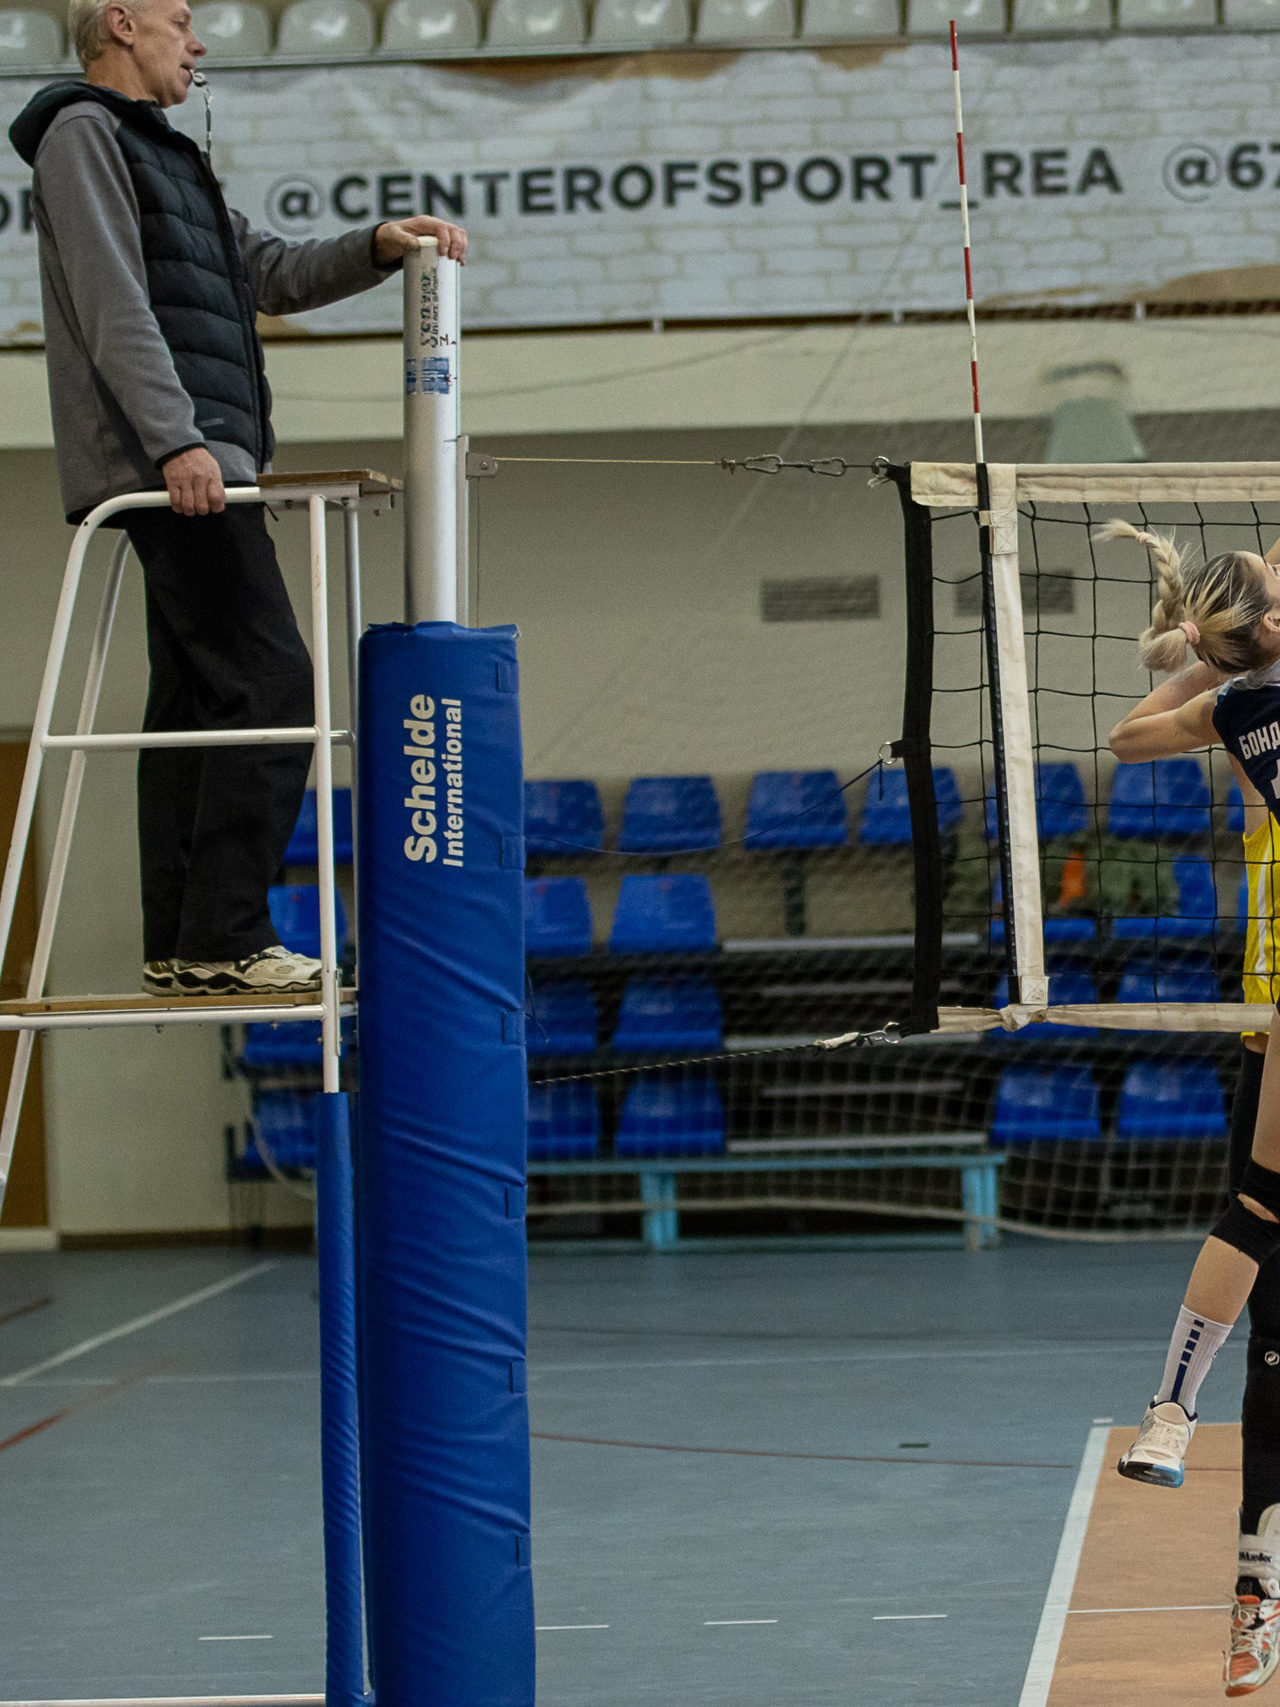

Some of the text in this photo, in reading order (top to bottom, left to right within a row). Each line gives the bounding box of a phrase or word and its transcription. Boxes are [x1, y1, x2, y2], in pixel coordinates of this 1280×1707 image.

[263, 147, 1124, 237] @CENTEROFSPORT_REA
[403, 693, 438, 864] Schelde
[440, 697, 465, 868] International
